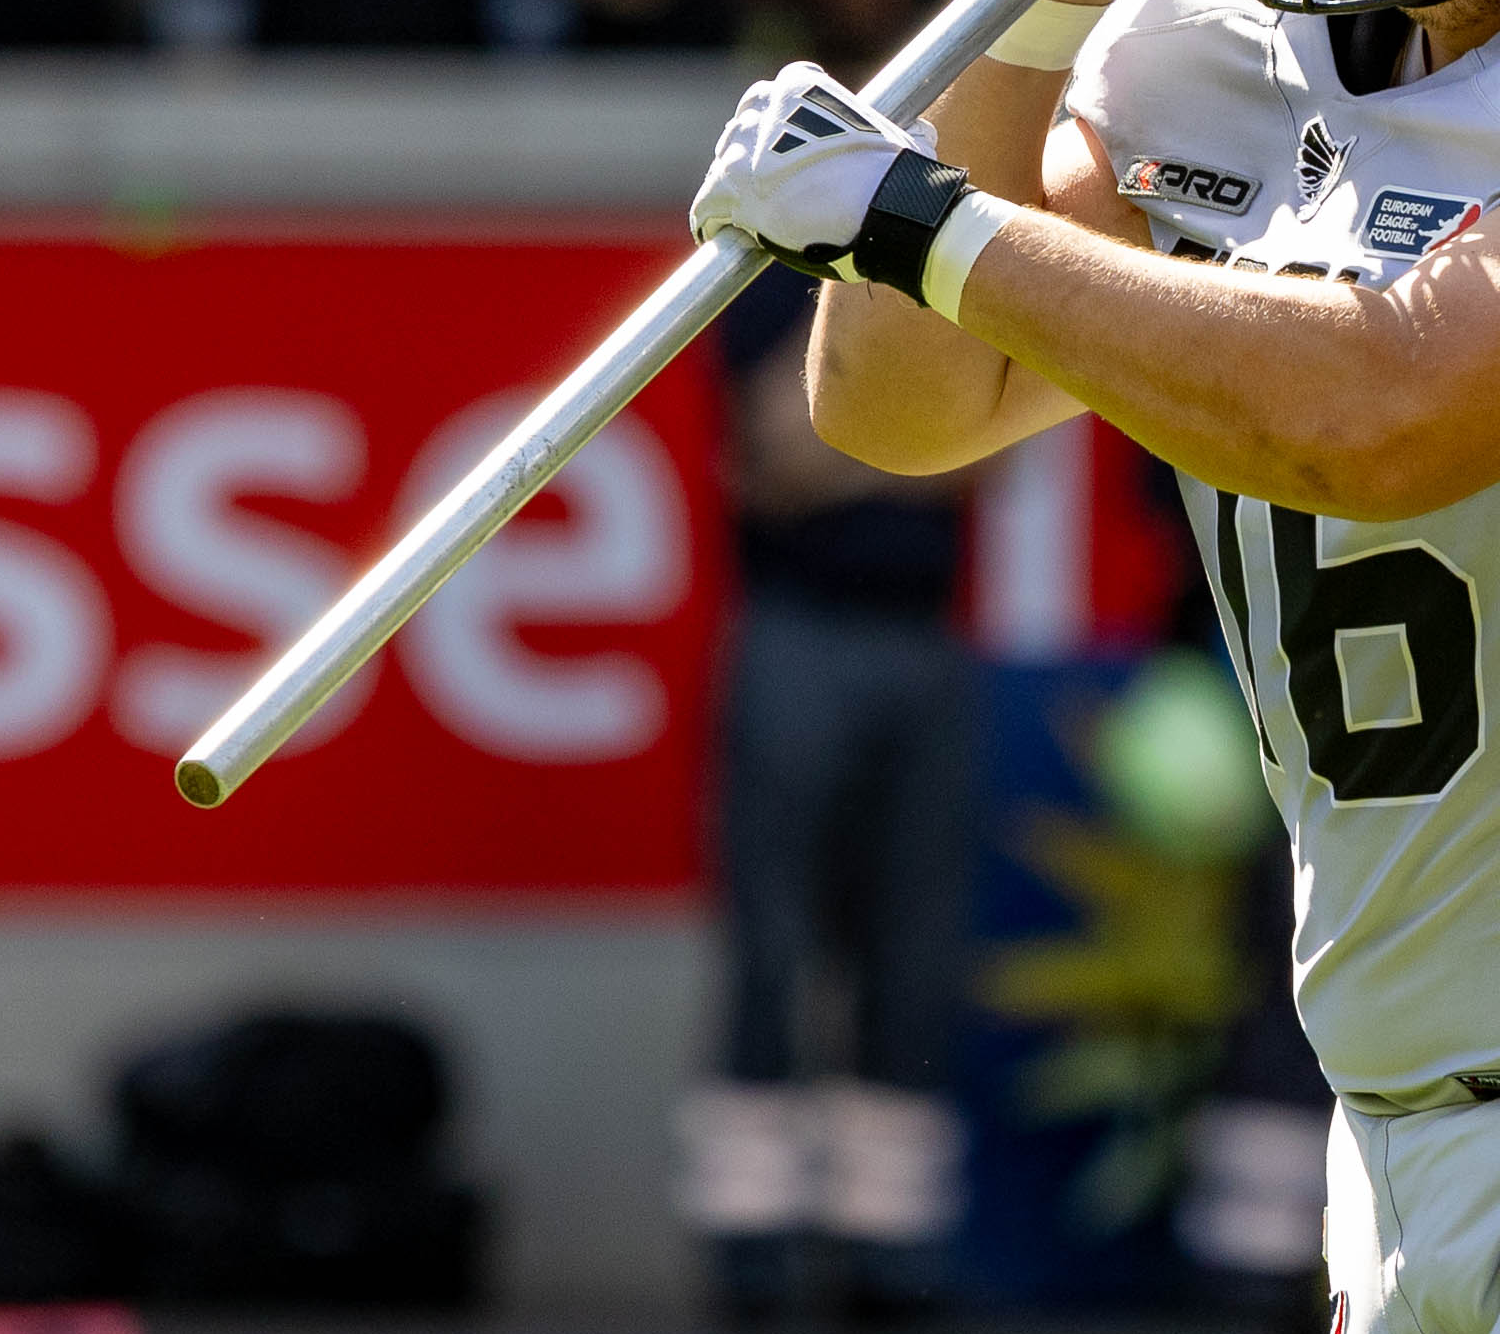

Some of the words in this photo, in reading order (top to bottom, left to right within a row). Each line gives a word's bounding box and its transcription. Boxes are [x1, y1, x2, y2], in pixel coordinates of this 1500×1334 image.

[1380, 198, 1434, 218] EUROPEAN
[1374, 213, 1414, 230] LEAGUE
[1368, 228, 1417, 246] FOOTBALL
